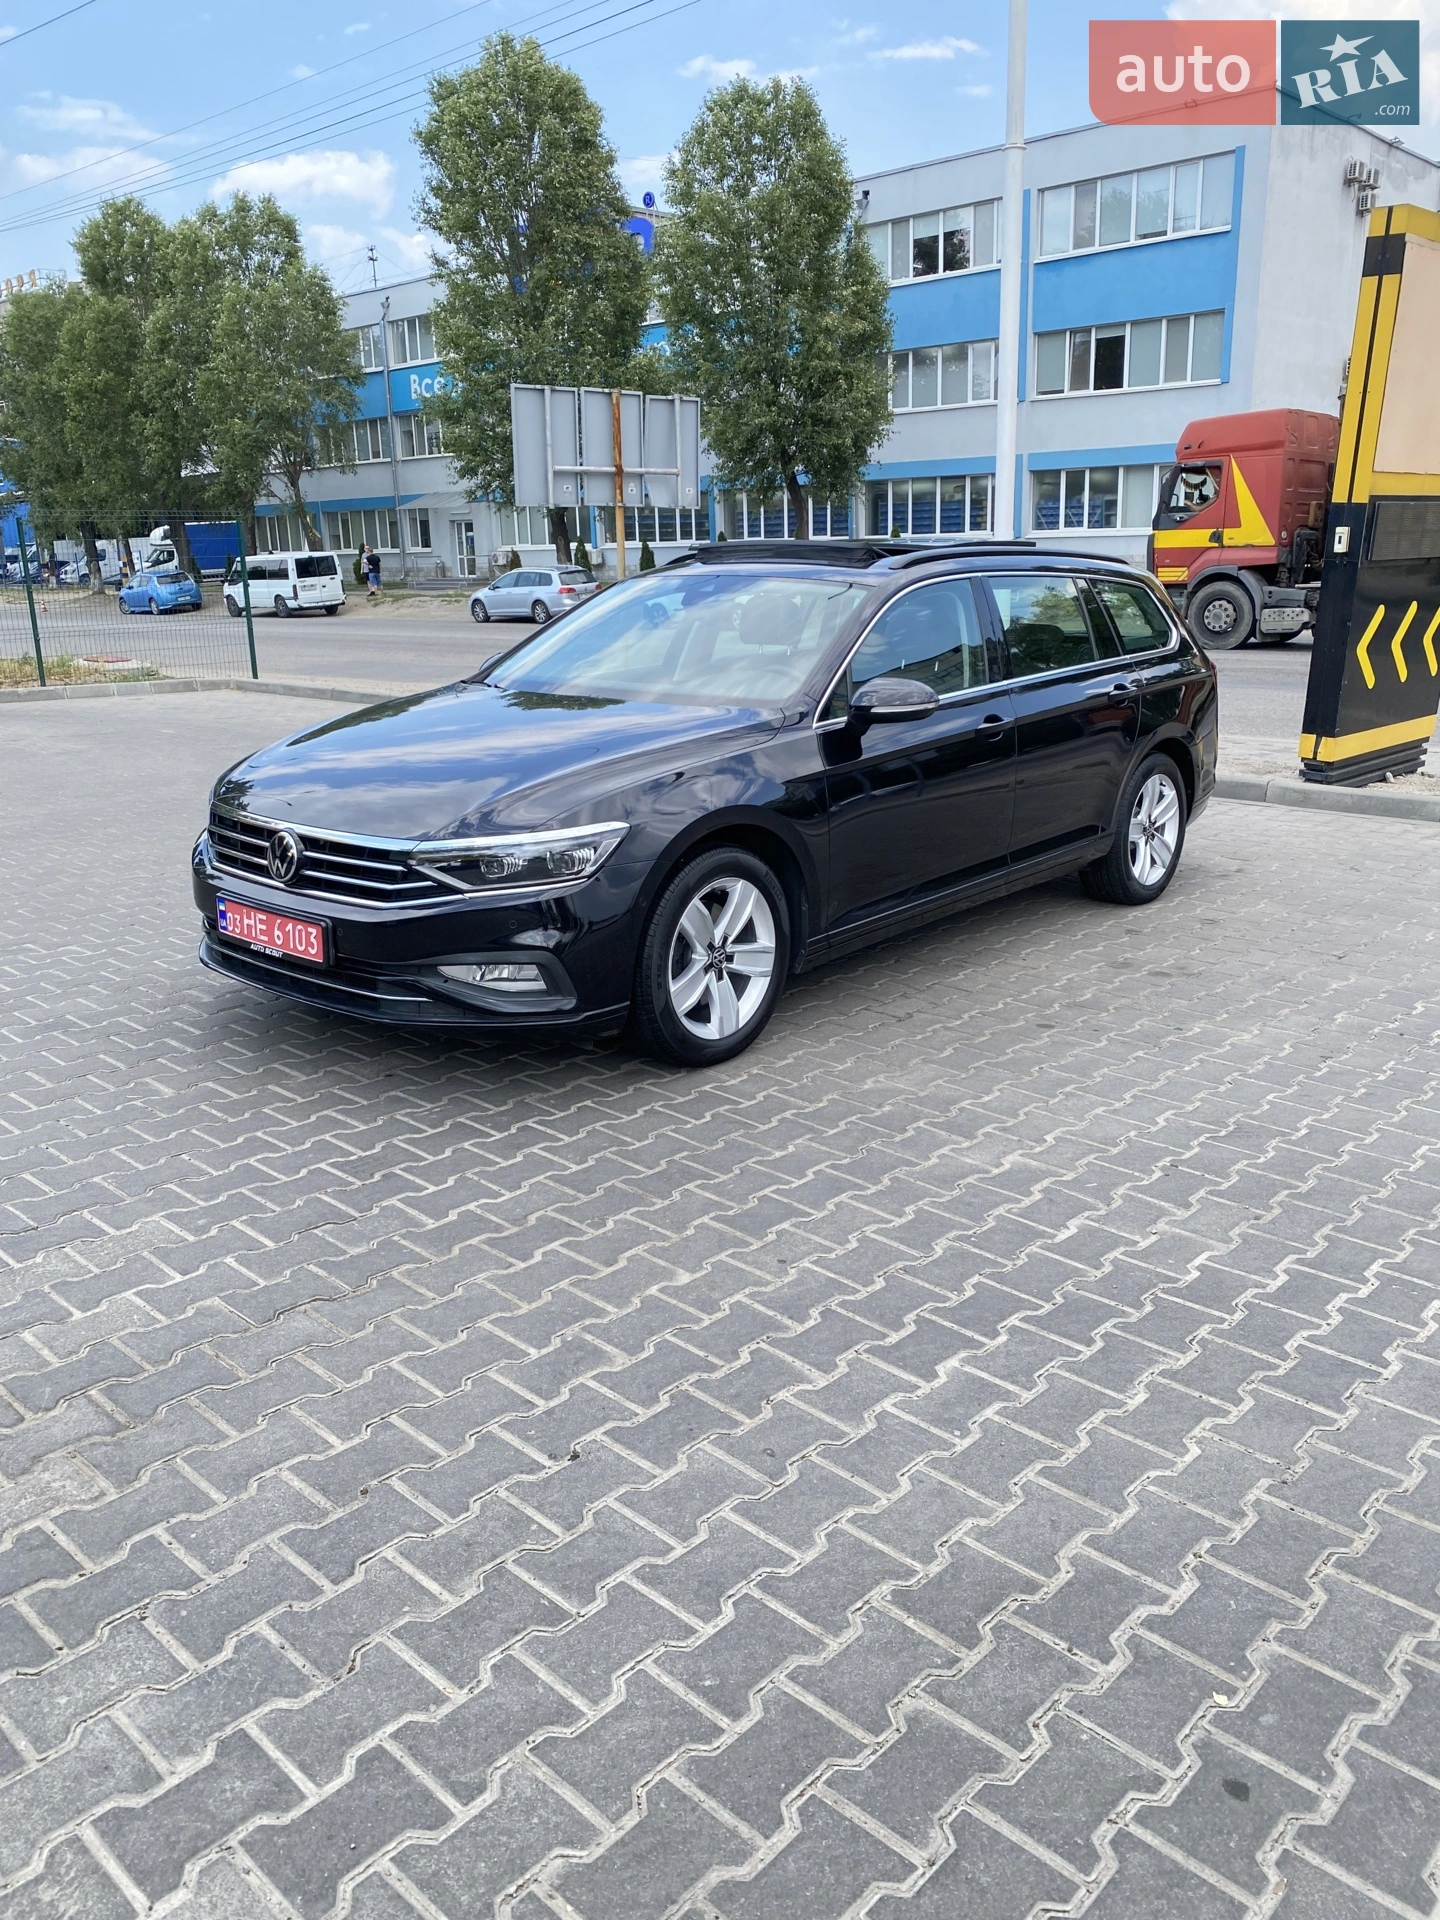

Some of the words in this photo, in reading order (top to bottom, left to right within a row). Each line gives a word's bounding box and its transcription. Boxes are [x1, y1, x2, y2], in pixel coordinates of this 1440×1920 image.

[274, 919, 318, 955] 6103
[250, 943, 265, 953] AUTO
[265, 947, 283, 958] SCOUT
